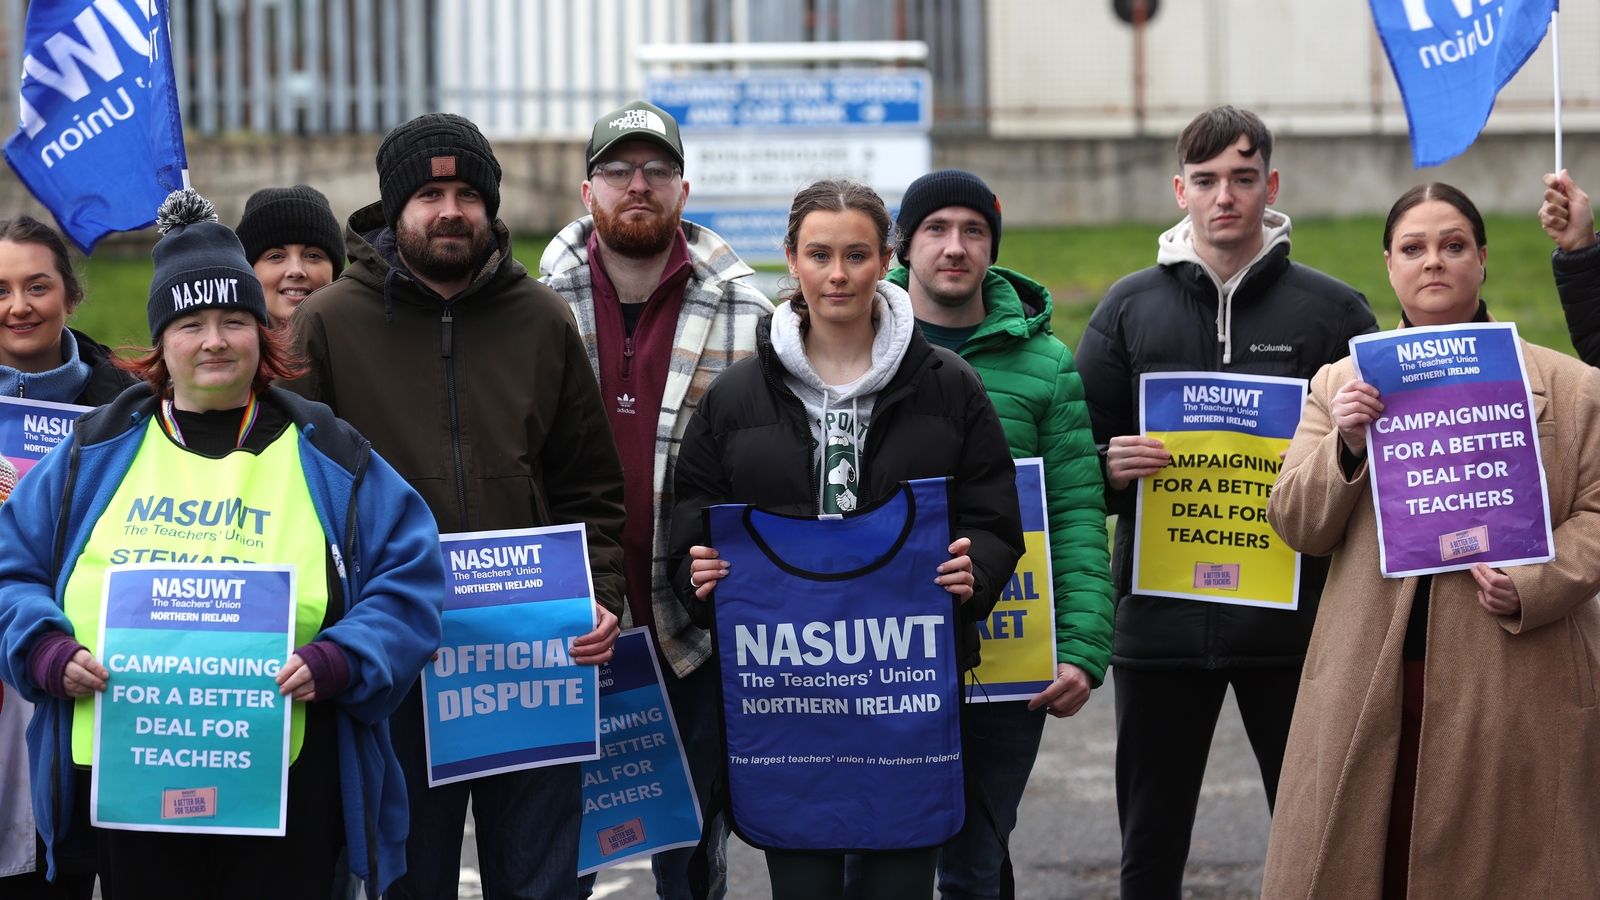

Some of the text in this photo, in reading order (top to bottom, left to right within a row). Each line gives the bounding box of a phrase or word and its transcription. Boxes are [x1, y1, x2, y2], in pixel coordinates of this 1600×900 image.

[609, 116, 647, 128] NORTH
[625, 109, 647, 118] THE
[619, 122, 647, 130] FACE
[171, 278, 238, 311] NASUWT
[1258, 344, 1292, 352] Columbia
[1396, 337, 1477, 363] NASUWT
[1400, 355, 1478, 371] The Teachers' Union
[1402, 366, 1480, 384] NORTHERN IRELAND
[1183, 385, 1263, 408] NASUWT
[1183, 403, 1259, 416] The Teachers' Union
[1375, 402, 1525, 434] CAMPAIGNING
[24, 413, 74, 437] NASU
[1183, 414, 1257, 428] NORTHERN IRELAND
[24, 432, 63, 444] The Teach
[24, 443, 54, 454] NORTH
[1382, 430, 1526, 462] FOR A BETTER
[1160, 454, 1284, 474] AMPAIGNIN
[1406, 461, 1509, 488] DEAL FOR
[1152, 478, 1273, 498] FOR A BETTE
[1172, 503, 1268, 523] DEAL FOR
[1405, 489, 1514, 516] TEACHERS
[126, 495, 271, 535] NASUWT
[124, 524, 264, 549] The Teachers' Union
[1167, 528, 1270, 549] TEACHERS
[110, 549, 257, 565] STEW
[450, 544, 542, 571] NASUWT
[453, 566, 542, 581] The Teachers' Union
[152, 578, 246, 599] NASUWT
[454, 578, 543, 595] NORTHERN IRELAND
[151, 598, 241, 609] The Teachers' Union
[150, 611, 240, 623] NORTHERN IRELAND
[735, 615, 945, 666] NASUWT
[109, 653, 280, 677] CAMPAIGNING
[738, 666, 936, 688] The Teachers' Union
[113, 685, 275, 708] FOR A BETTER
[437, 678, 584, 722] DISPUTE
[742, 694, 941, 715] NORTHERN IRELAND
[135, 717, 249, 738] DEAL FOR
[130, 747, 251, 769] TEACHERS
[729, 752, 960, 766] The largest teachers' union in Northern Ireland
[611, 759, 654, 781] FOR
[583, 781, 663, 815] ACHERS
